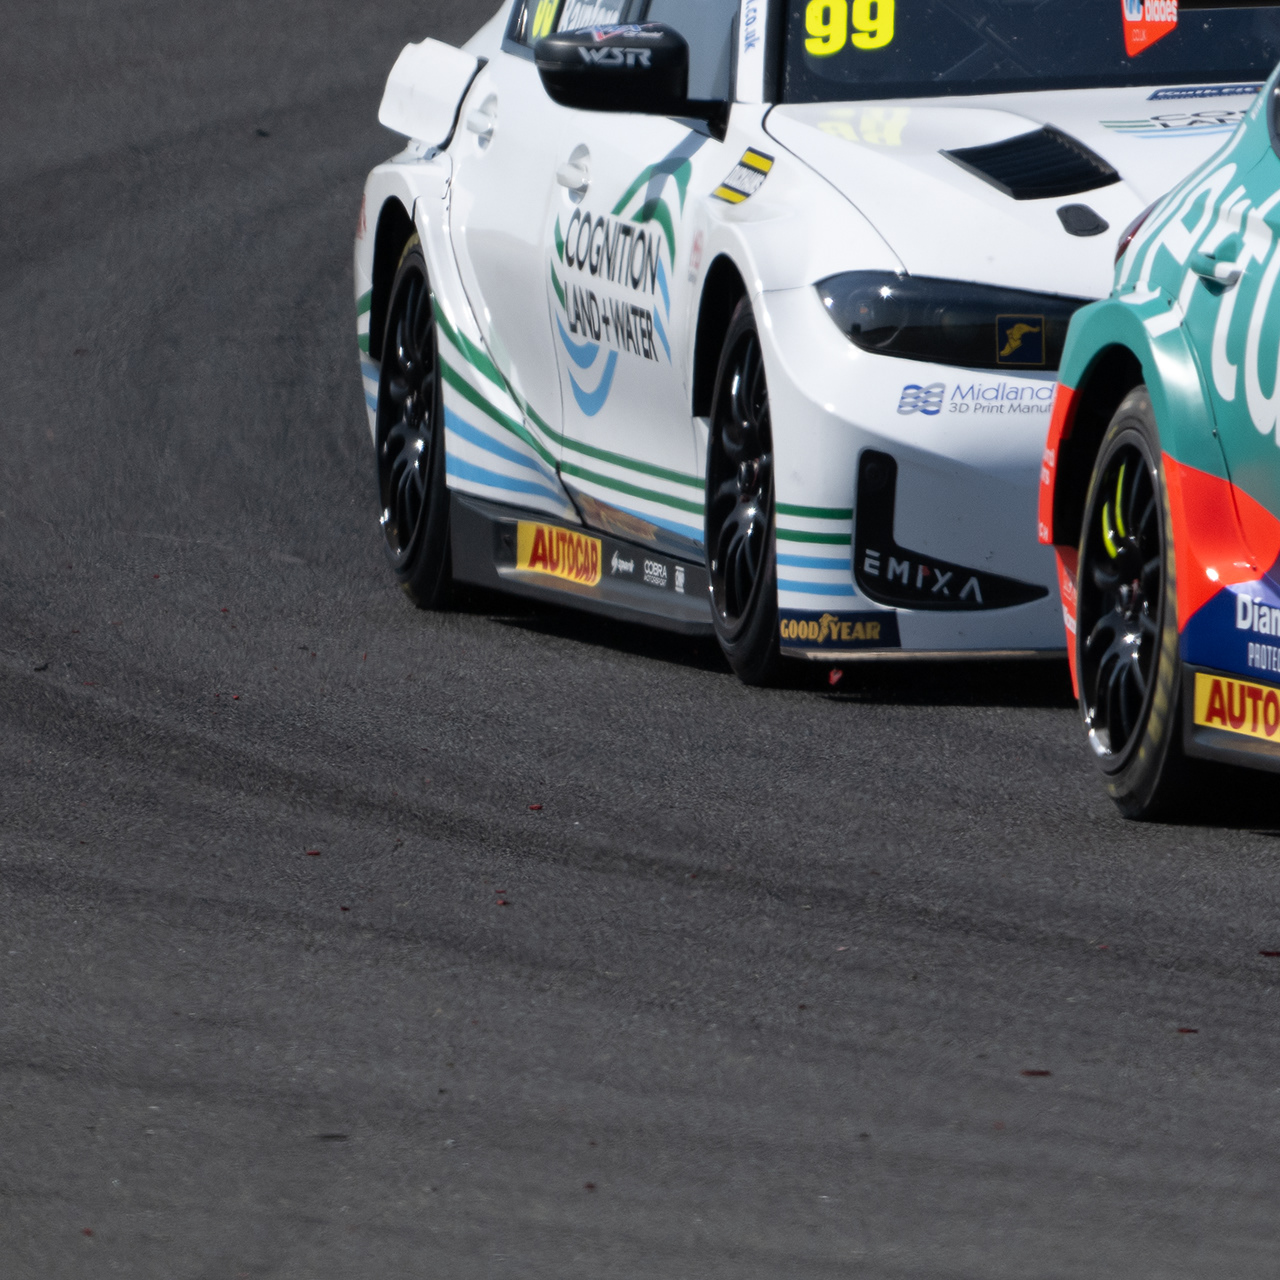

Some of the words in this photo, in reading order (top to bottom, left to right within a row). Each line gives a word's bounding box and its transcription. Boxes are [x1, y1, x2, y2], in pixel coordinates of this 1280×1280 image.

[578, 46, 652, 67] WSR
[565, 206, 661, 297] COGNITION
[564, 279, 601, 343] LAND
[608, 294, 660, 363] WATER
[948, 402, 967, 414] 3D
[973, 402, 1005, 415] Print
[529, 526, 599, 583] AUTOCAR
[643, 559, 668, 579] COBRA
[780, 613, 881, 643] GOODYEAR
